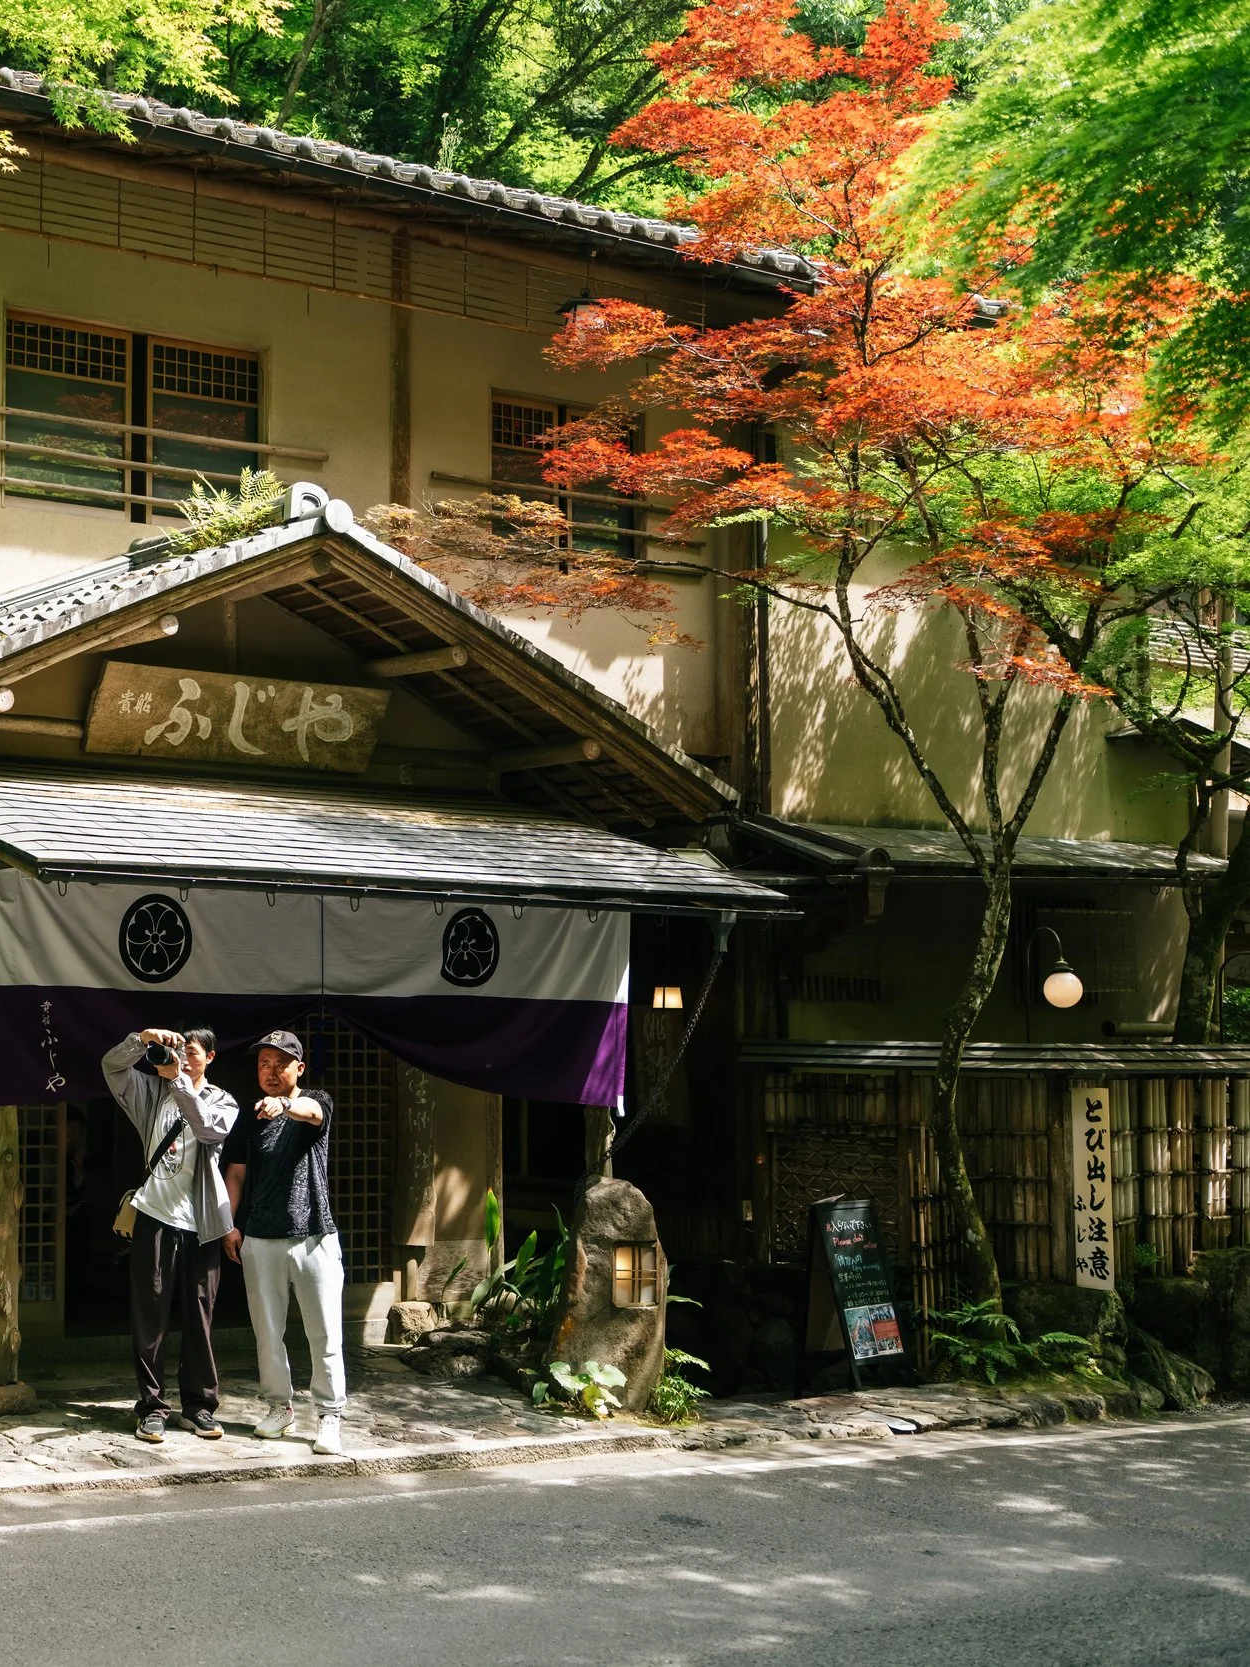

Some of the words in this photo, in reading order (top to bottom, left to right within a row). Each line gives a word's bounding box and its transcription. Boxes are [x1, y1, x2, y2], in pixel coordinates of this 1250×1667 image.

[144, 678, 354, 762] ふじや
[1085, 1097, 1110, 1280] とび出し注意
[1074, 1195, 1089, 1273] ふじや
